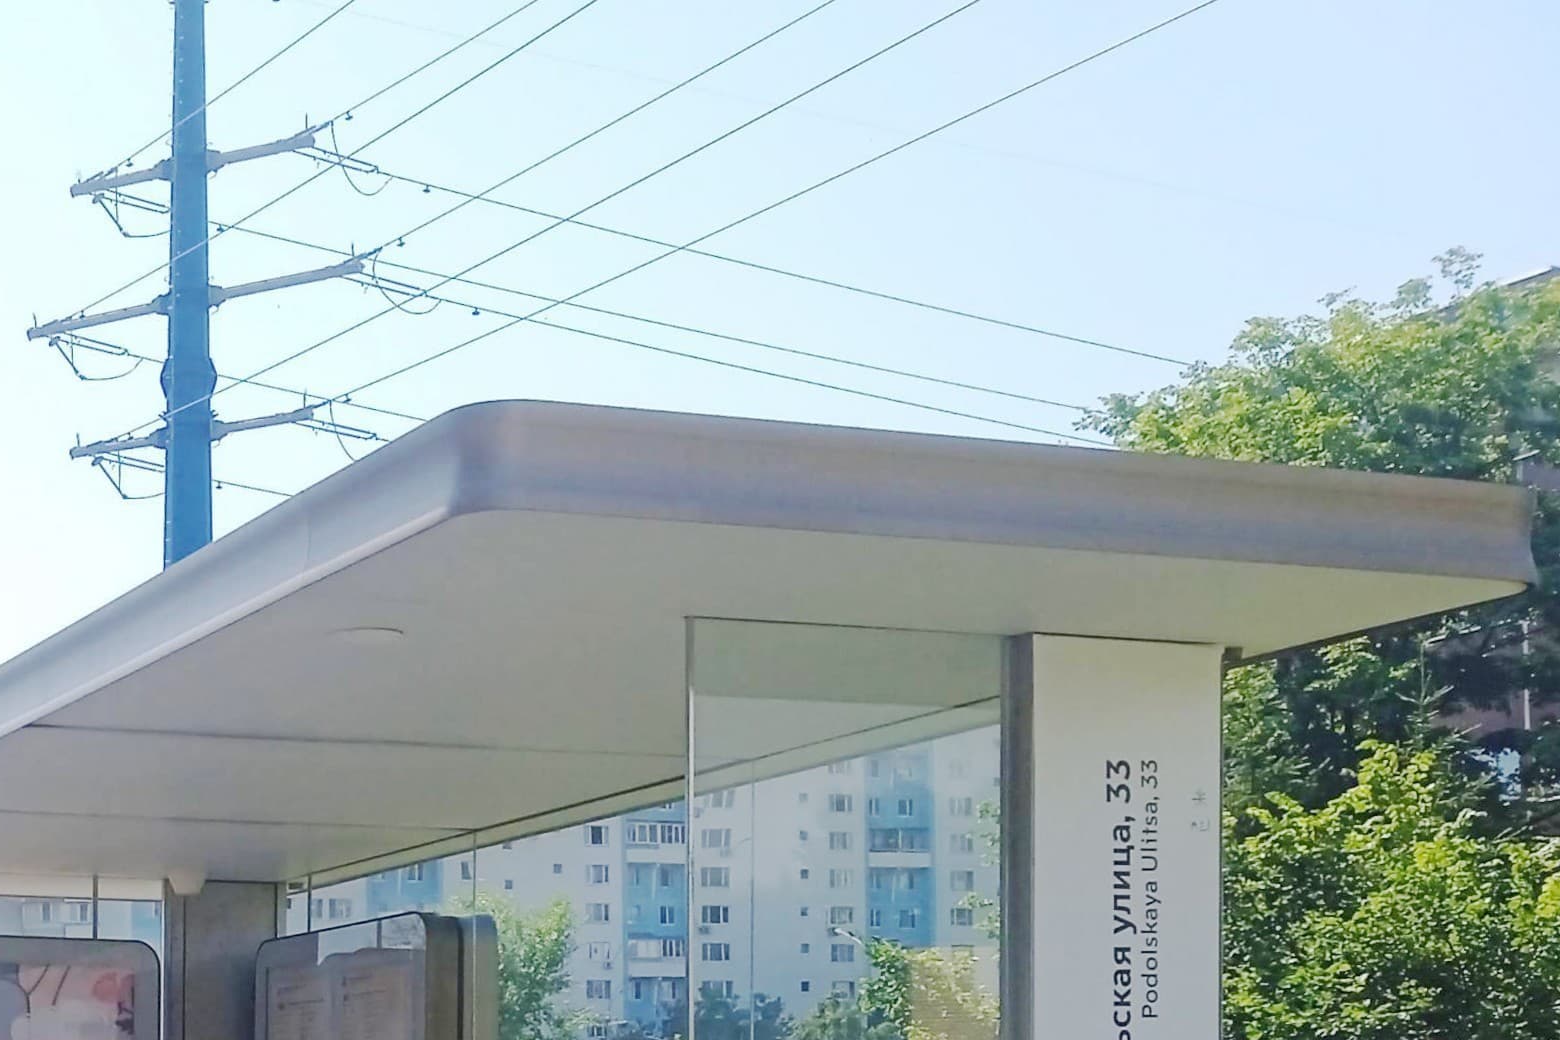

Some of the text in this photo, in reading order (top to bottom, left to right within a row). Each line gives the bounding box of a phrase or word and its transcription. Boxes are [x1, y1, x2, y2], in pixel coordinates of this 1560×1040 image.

[1105, 759, 1132, 804] 33
[1111, 815, 1137, 934] улица,
[1139, 759, 1162, 1019] Podolskaya Ulitsa, 33
